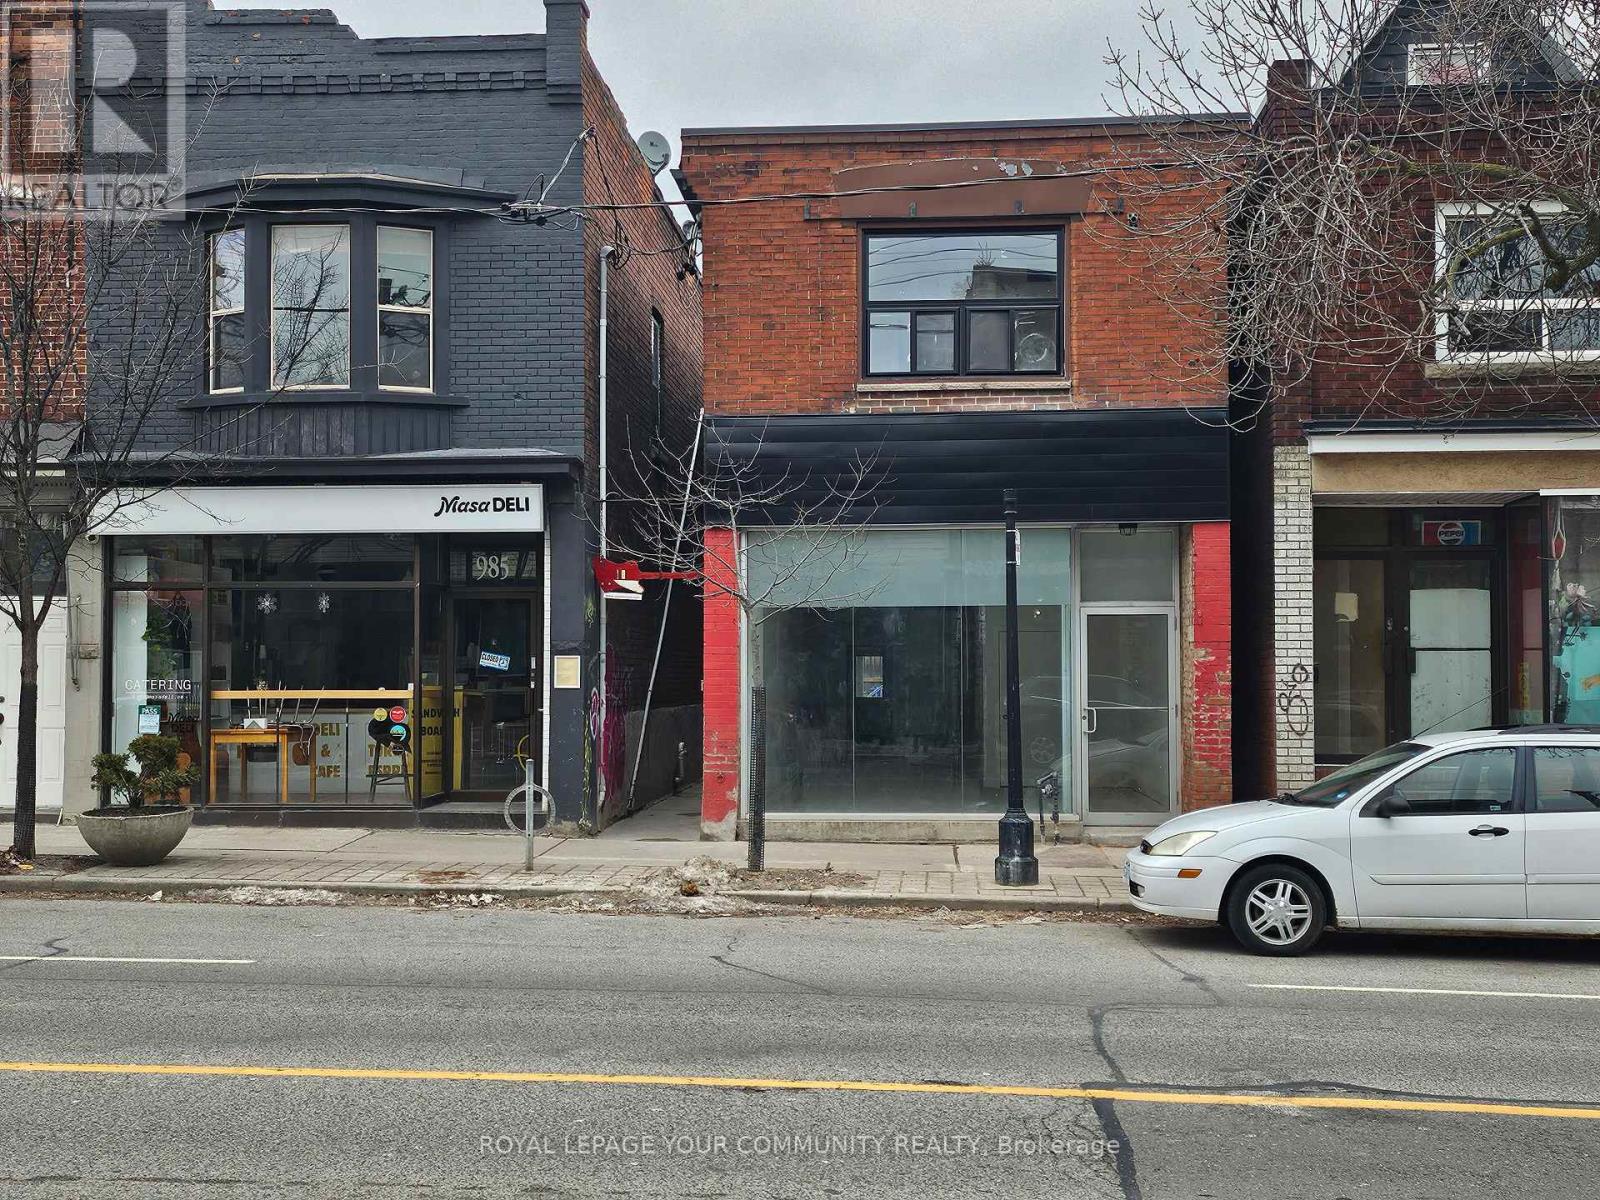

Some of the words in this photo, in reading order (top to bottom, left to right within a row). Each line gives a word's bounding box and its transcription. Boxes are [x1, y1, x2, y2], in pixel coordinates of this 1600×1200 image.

[434, 496, 490, 517] Masa
[493, 497, 530, 512] DELI
[476, 556, 509, 580] 985
[481, 652, 500, 663] CLOSED
[125, 680, 191, 690] CATERING
[143, 707, 158, 715] PASS
[321, 744, 331, 758] &
